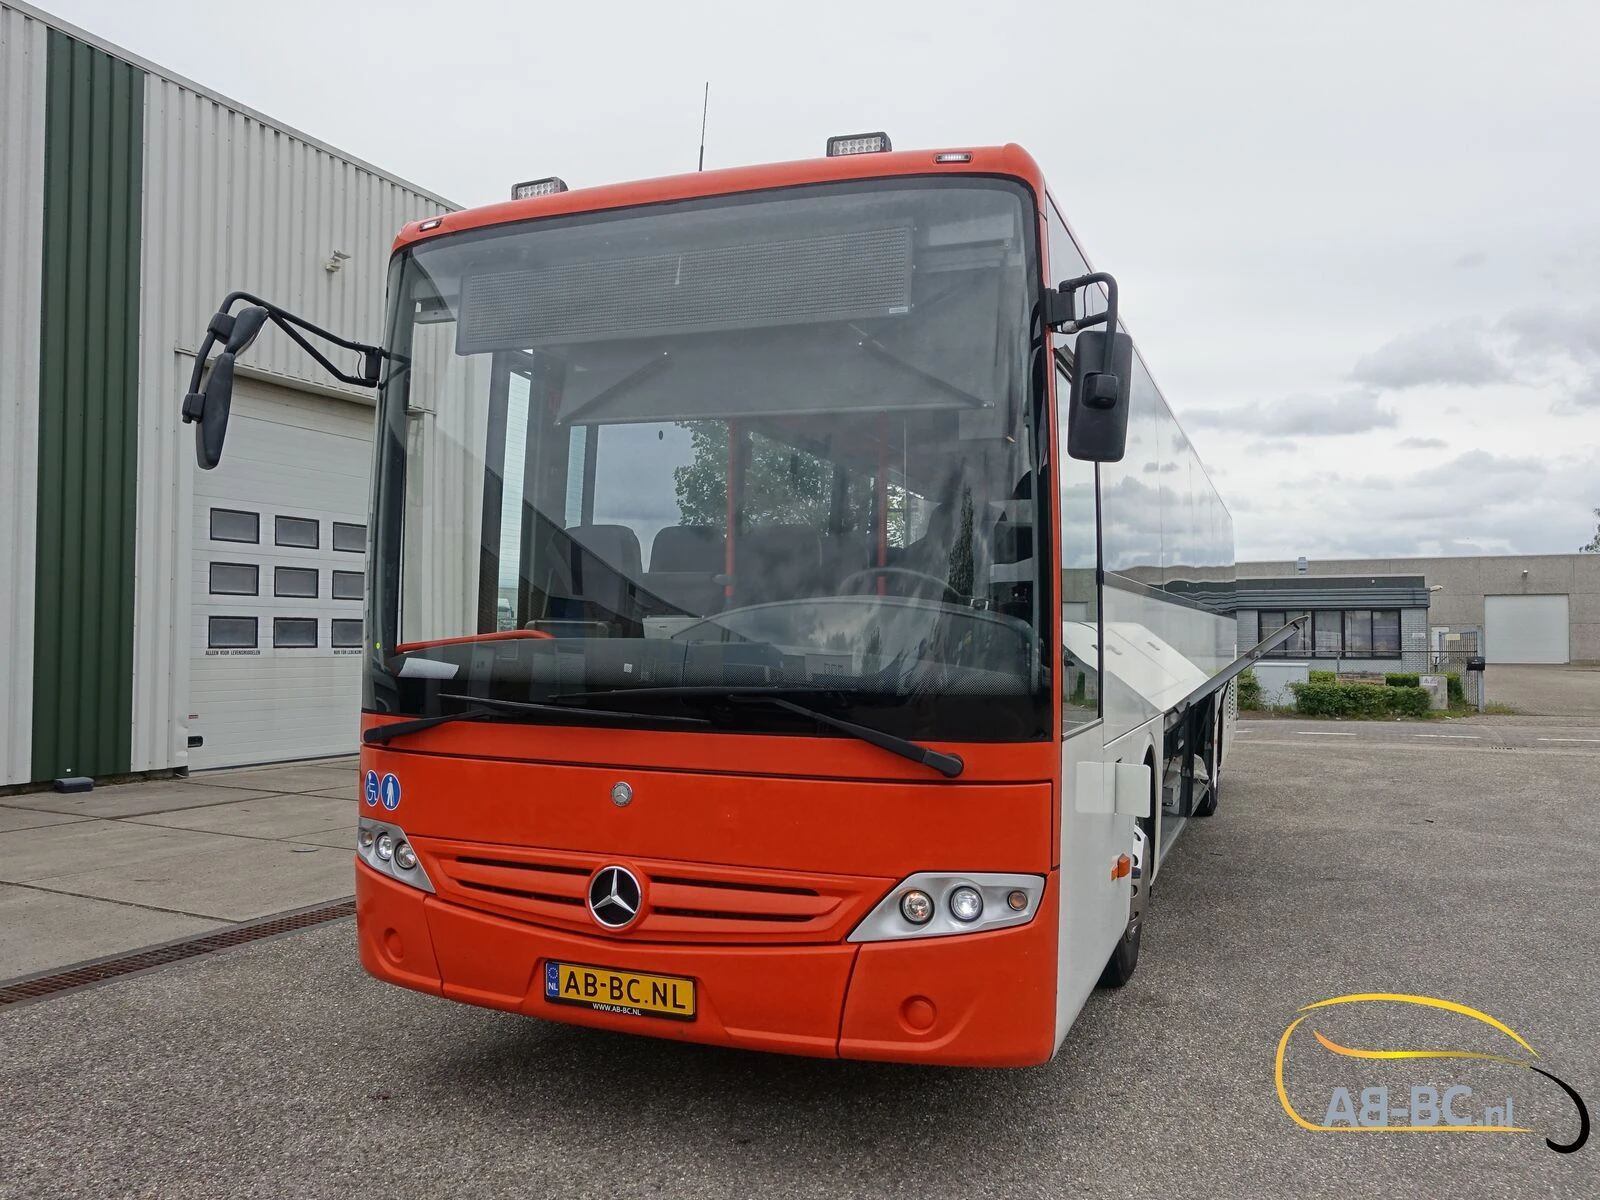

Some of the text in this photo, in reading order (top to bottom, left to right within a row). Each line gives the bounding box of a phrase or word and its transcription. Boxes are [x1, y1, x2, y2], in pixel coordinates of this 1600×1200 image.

[548, 971, 686, 1009] NL AB-BC.NL
[592, 1003, 641, 1016] WWW.AB-BC.NL
